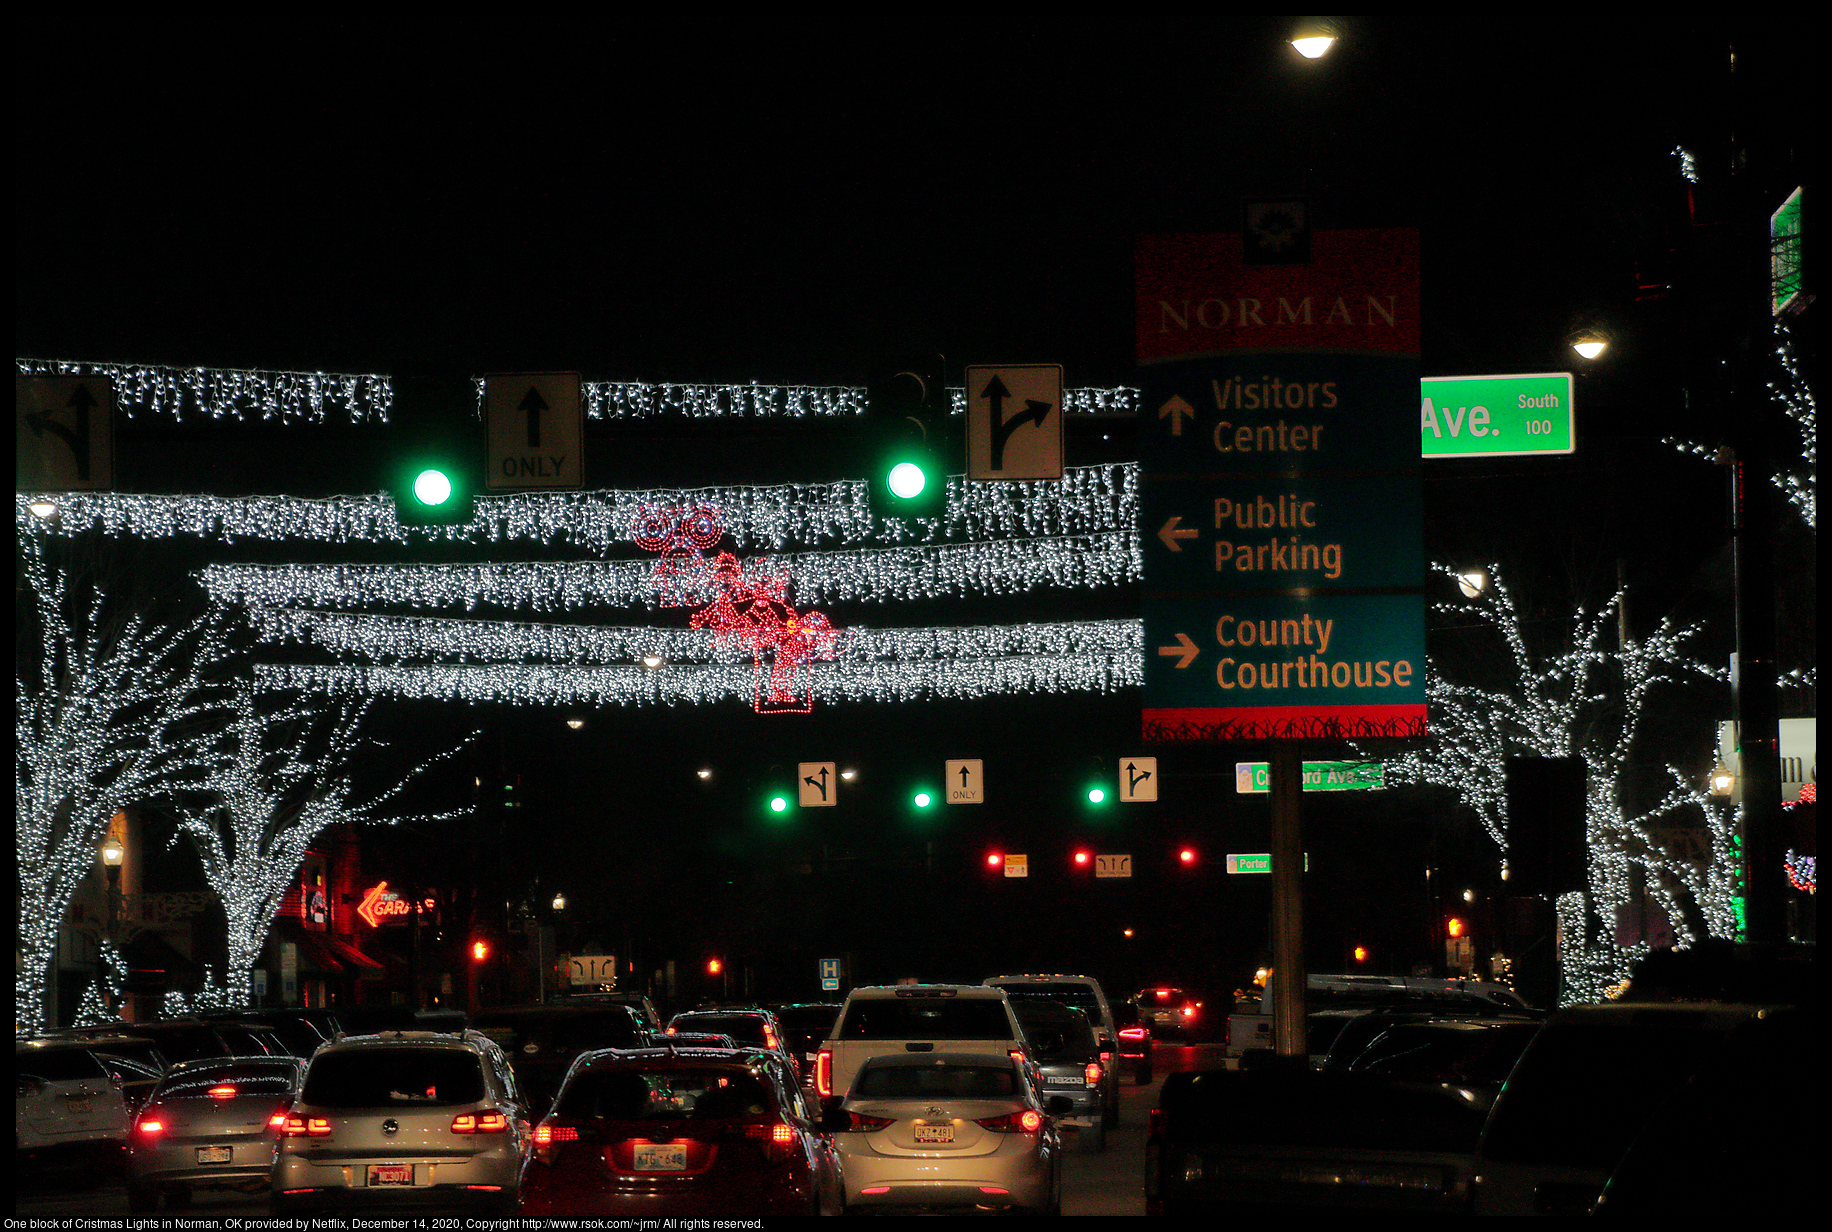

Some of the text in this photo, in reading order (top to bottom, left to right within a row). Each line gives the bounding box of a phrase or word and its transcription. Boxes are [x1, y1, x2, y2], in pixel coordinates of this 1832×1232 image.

[1158, 295, 1399, 333] NORMAN
[1212, 375, 1338, 410] Visitors
[1518, 393, 1559, 409] South
[1213, 420, 1324, 453] Center
[1526, 420, 1552, 435] 100
[502, 456, 566, 478] ONLY
[1214, 494, 1316, 529] Public
[1215, 537, 1343, 579] Parking
[1216, 613, 1333, 654] County
[1216, 654, 1413, 689] Courthouse
[953, 790, 976, 799] ONLY
[1239, 858, 1268, 869] Porter
[1047, 1076, 1084, 1085] mazda
